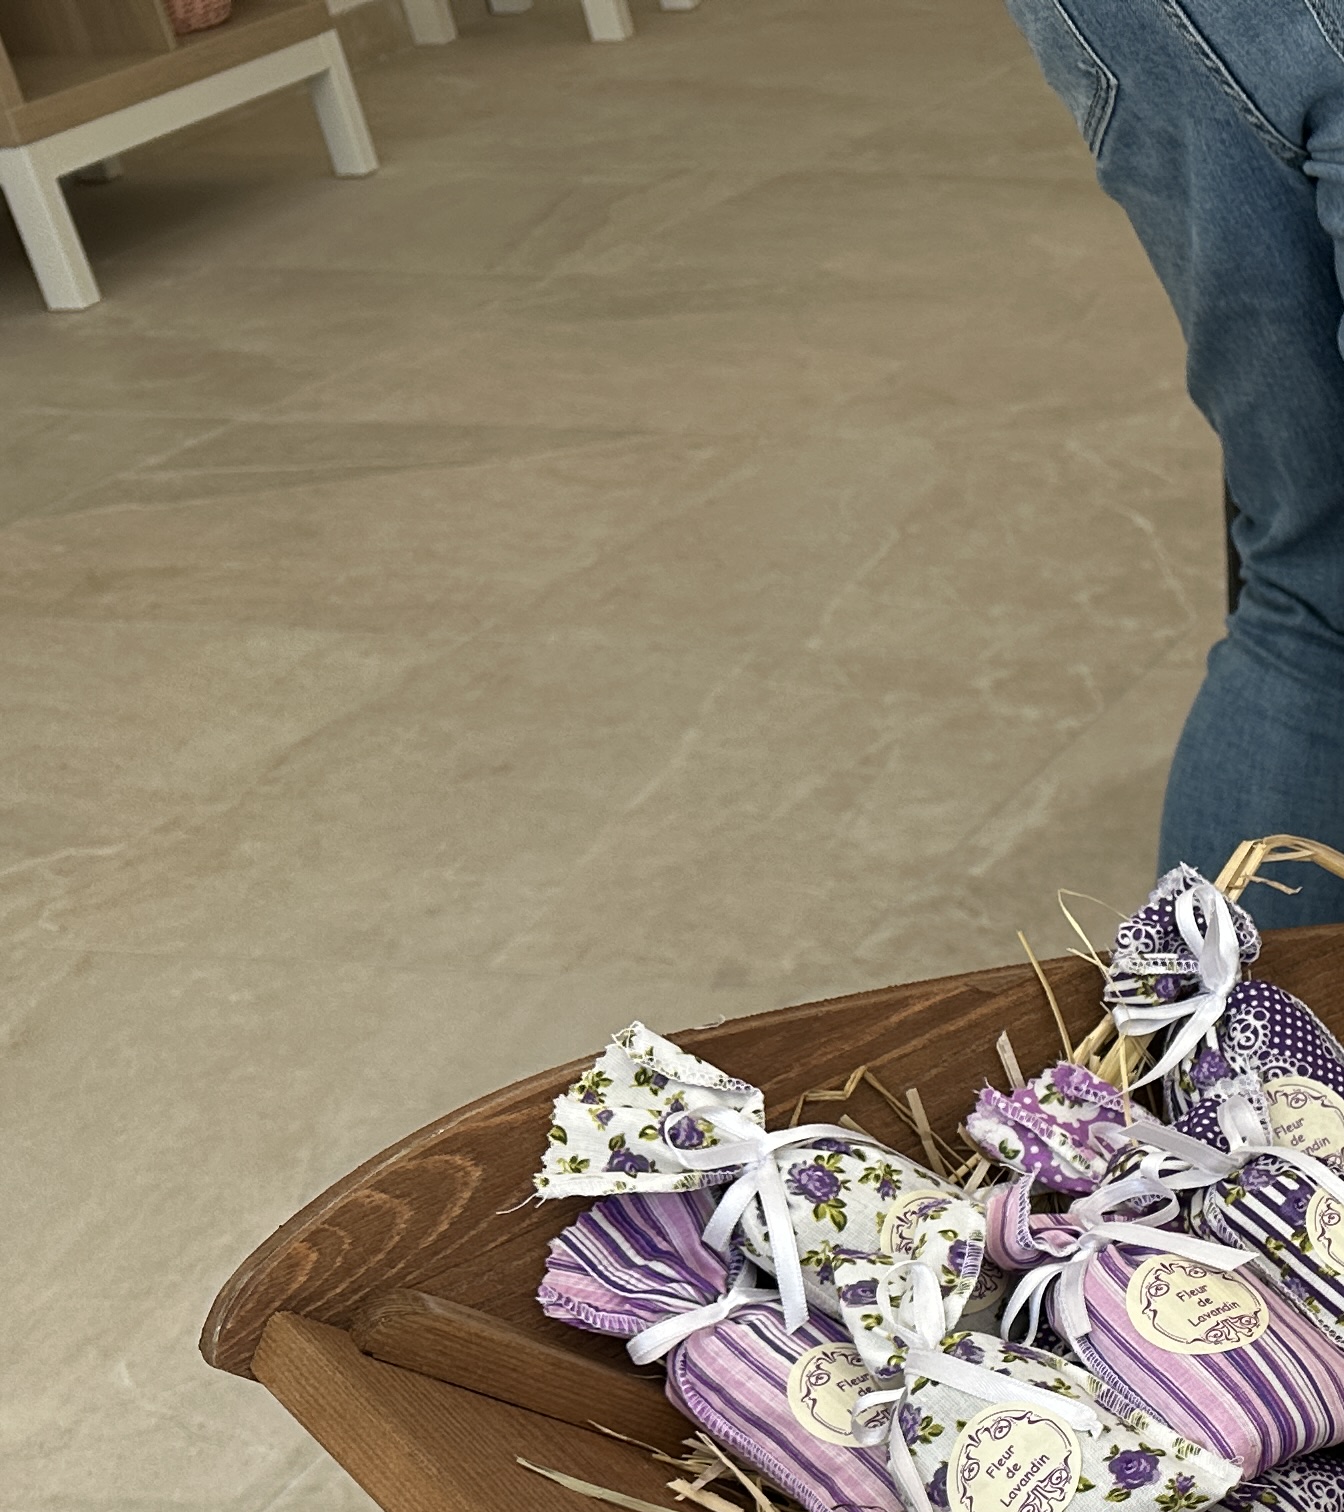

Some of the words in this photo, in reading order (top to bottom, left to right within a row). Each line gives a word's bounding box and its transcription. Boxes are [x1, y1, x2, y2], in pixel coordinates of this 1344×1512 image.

[1273, 1116, 1305, 1140] Fleur
[1290, 1133, 1307, 1148] de
[1175, 1284, 1209, 1303] Fleur
[1196, 1296, 1215, 1308] de
[1186, 1301, 1243, 1328] Lavandin
[836, 1372, 871, 1393] Fleur
[985, 1444, 1016, 1480] Fleur
[1005, 1461, 1022, 1480] de
[1000, 1453, 1051, 1508] Lavandin
